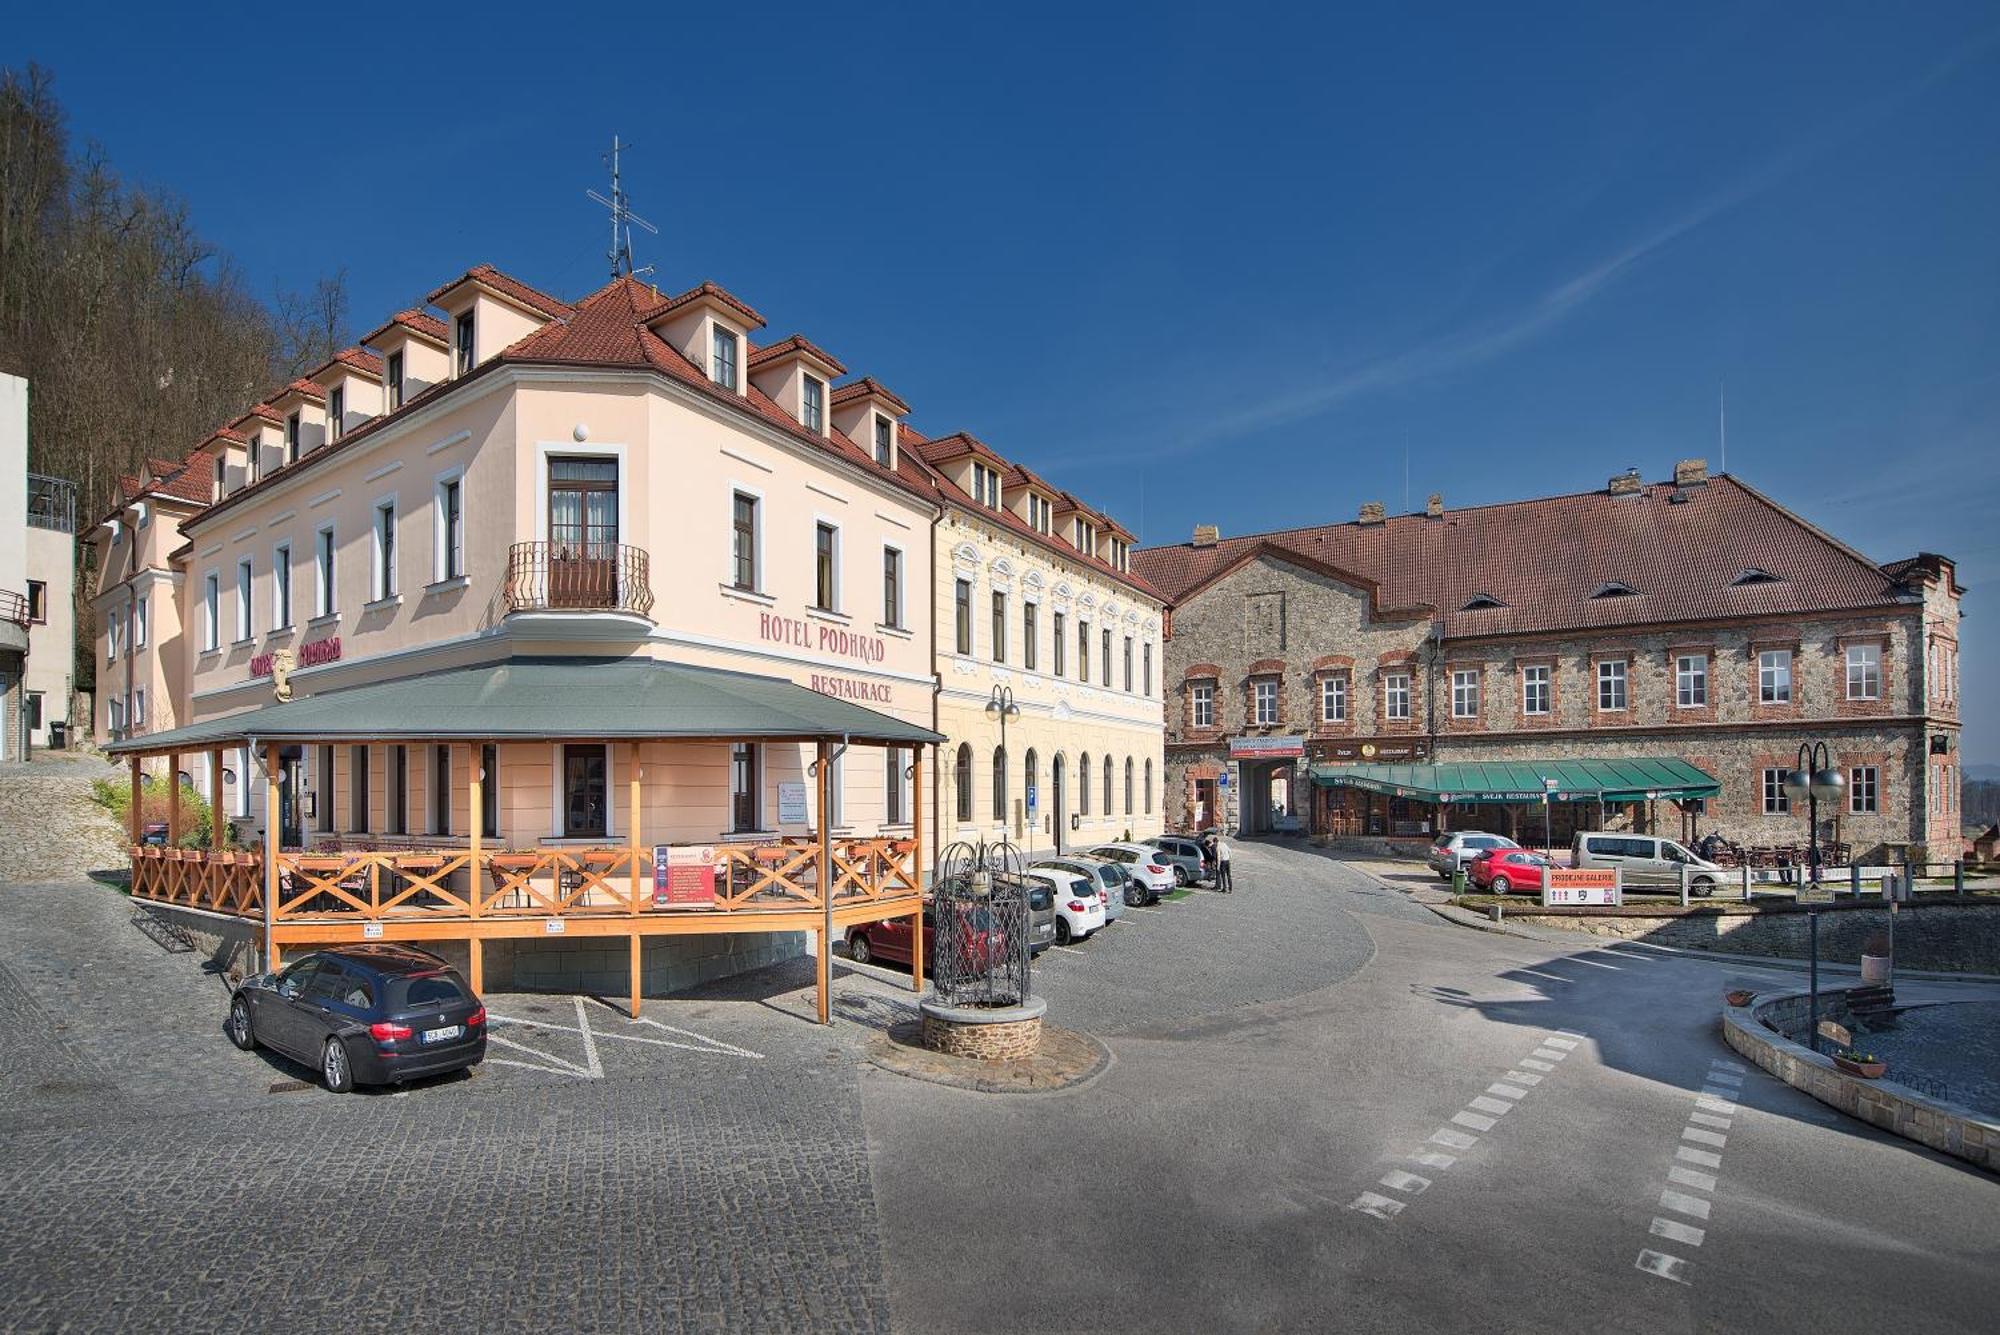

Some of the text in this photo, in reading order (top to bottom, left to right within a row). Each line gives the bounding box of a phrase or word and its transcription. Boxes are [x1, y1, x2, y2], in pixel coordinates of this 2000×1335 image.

[760, 613, 885, 664] HOTEL PODHRAD
[811, 674, 892, 703] RESTAURACE
